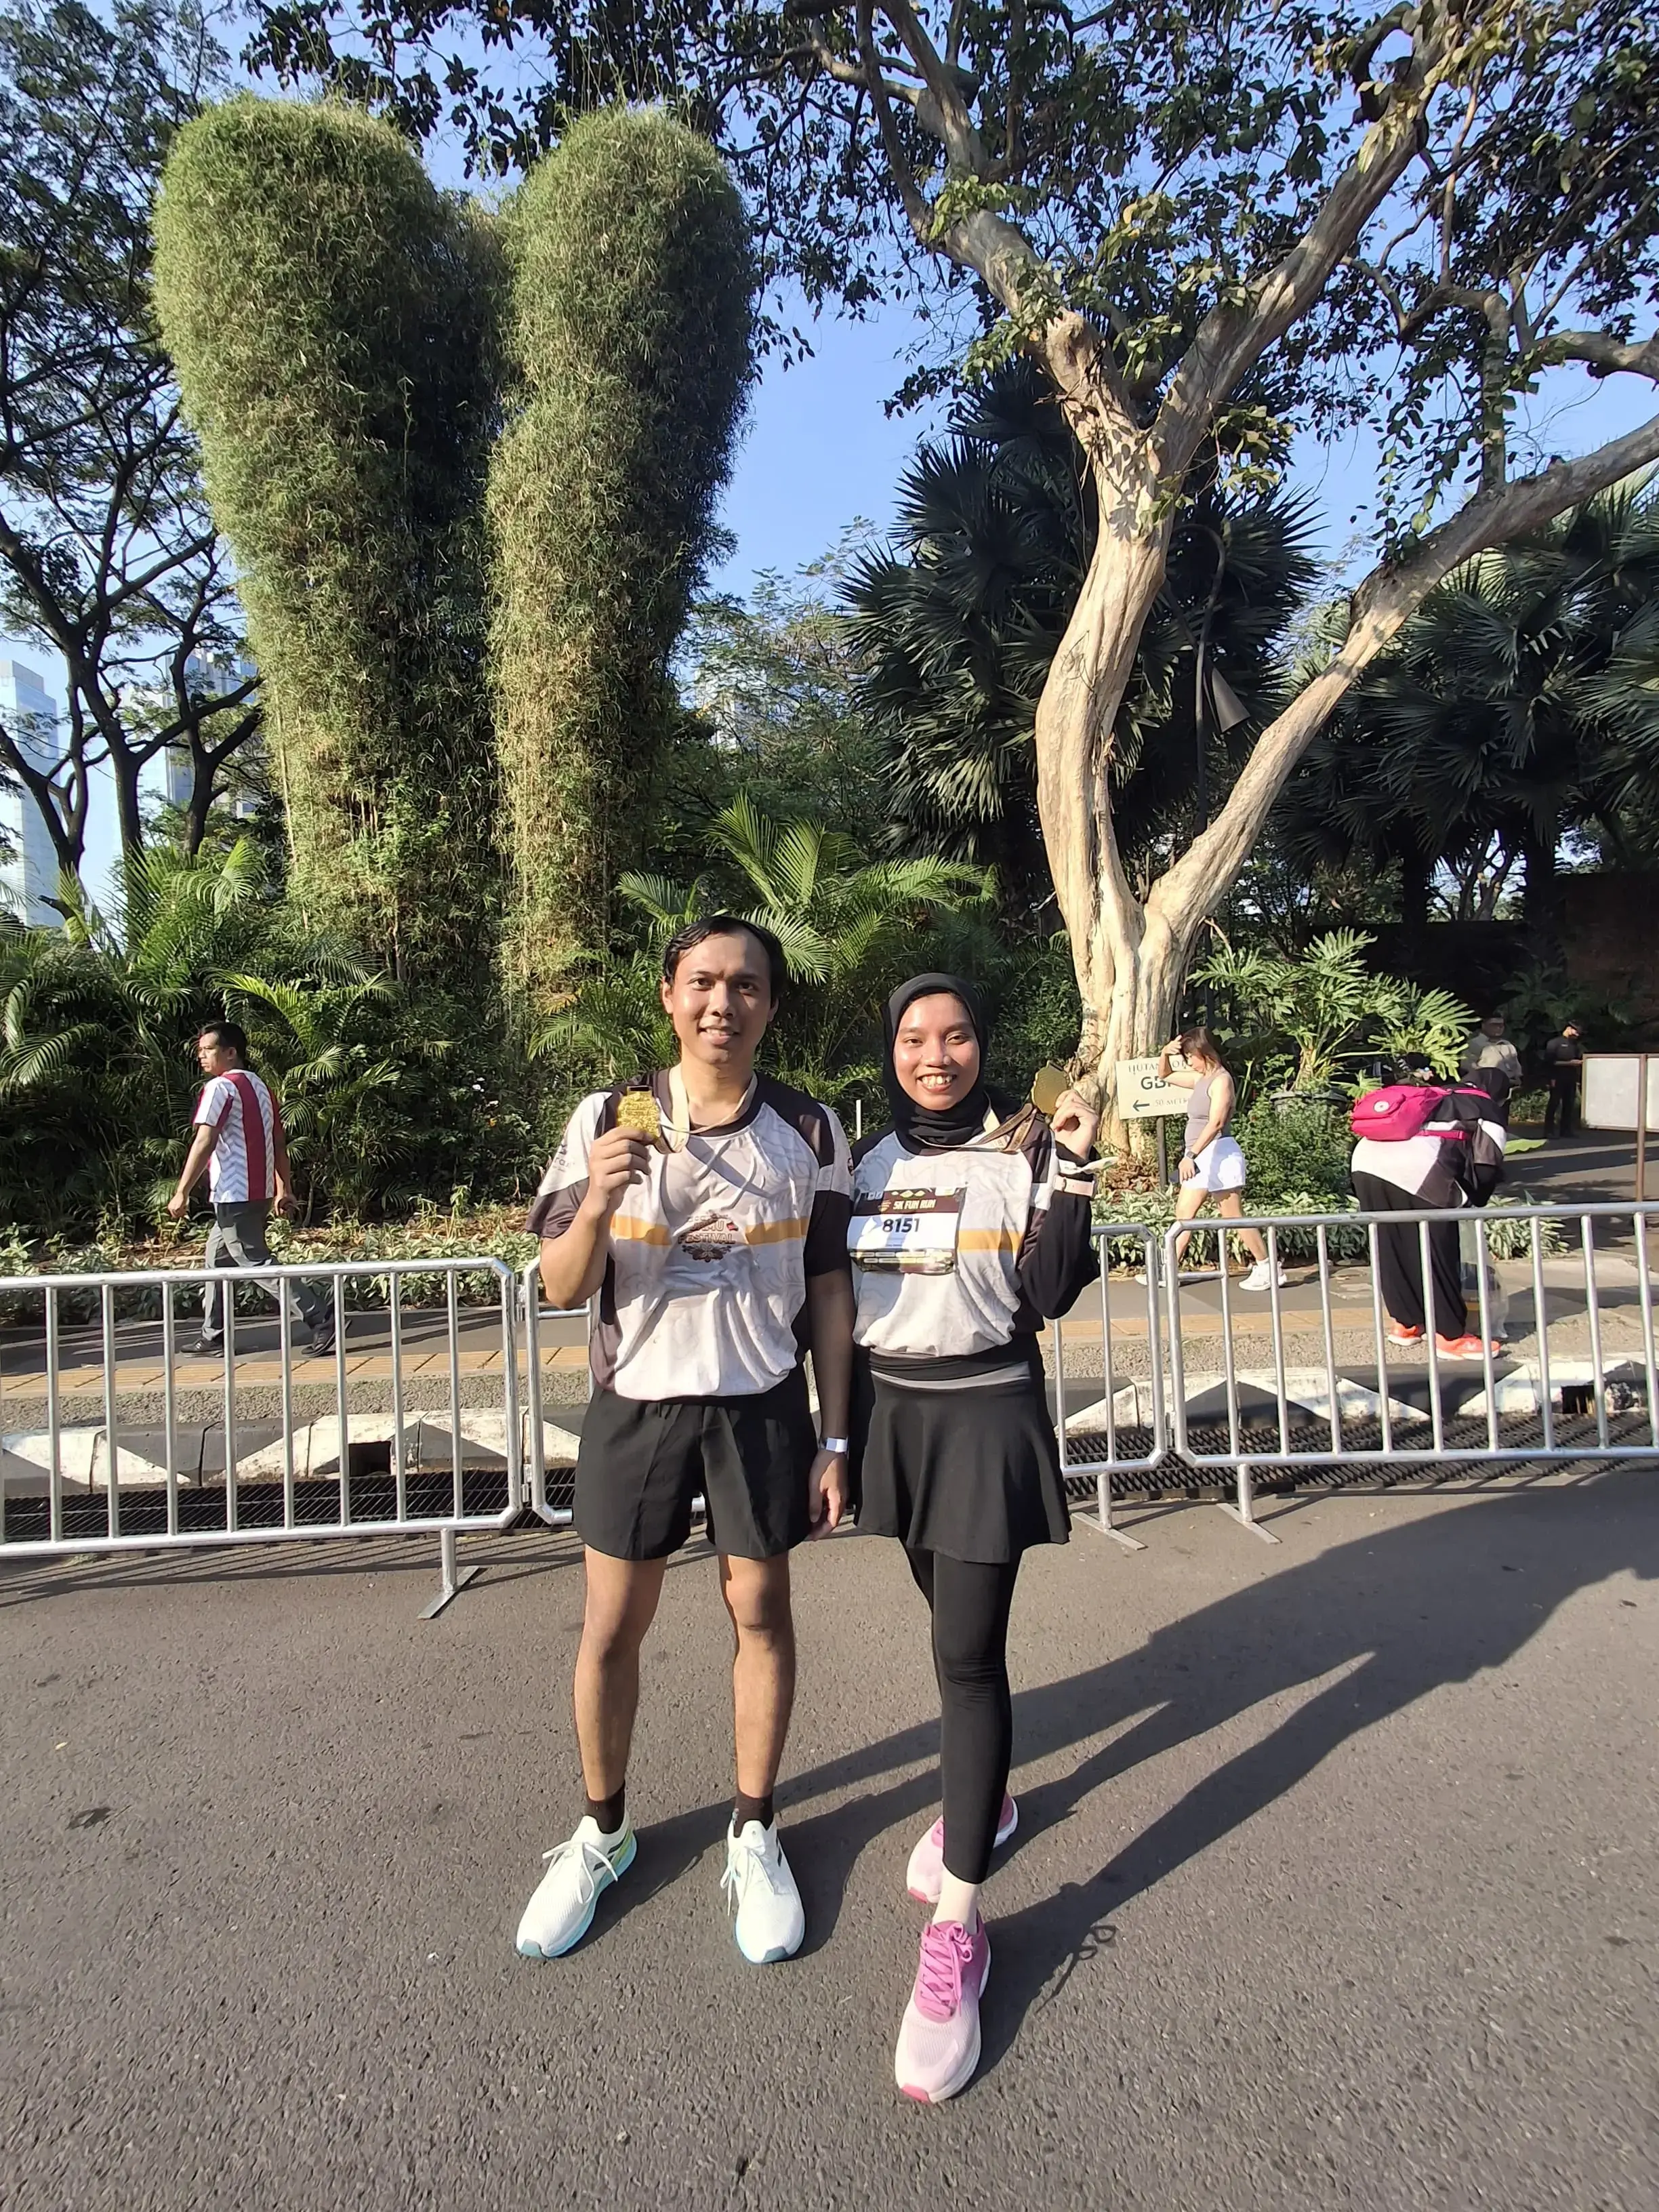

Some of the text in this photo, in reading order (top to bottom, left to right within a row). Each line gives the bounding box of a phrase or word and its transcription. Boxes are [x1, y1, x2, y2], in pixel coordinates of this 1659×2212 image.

[1141, 1076, 1171, 1090] GB
[893, 1199, 937, 1210] 5K FUN RUN
[882, 1218, 920, 1233] 8151
[678, 1232, 737, 1244] FESTIVAL
